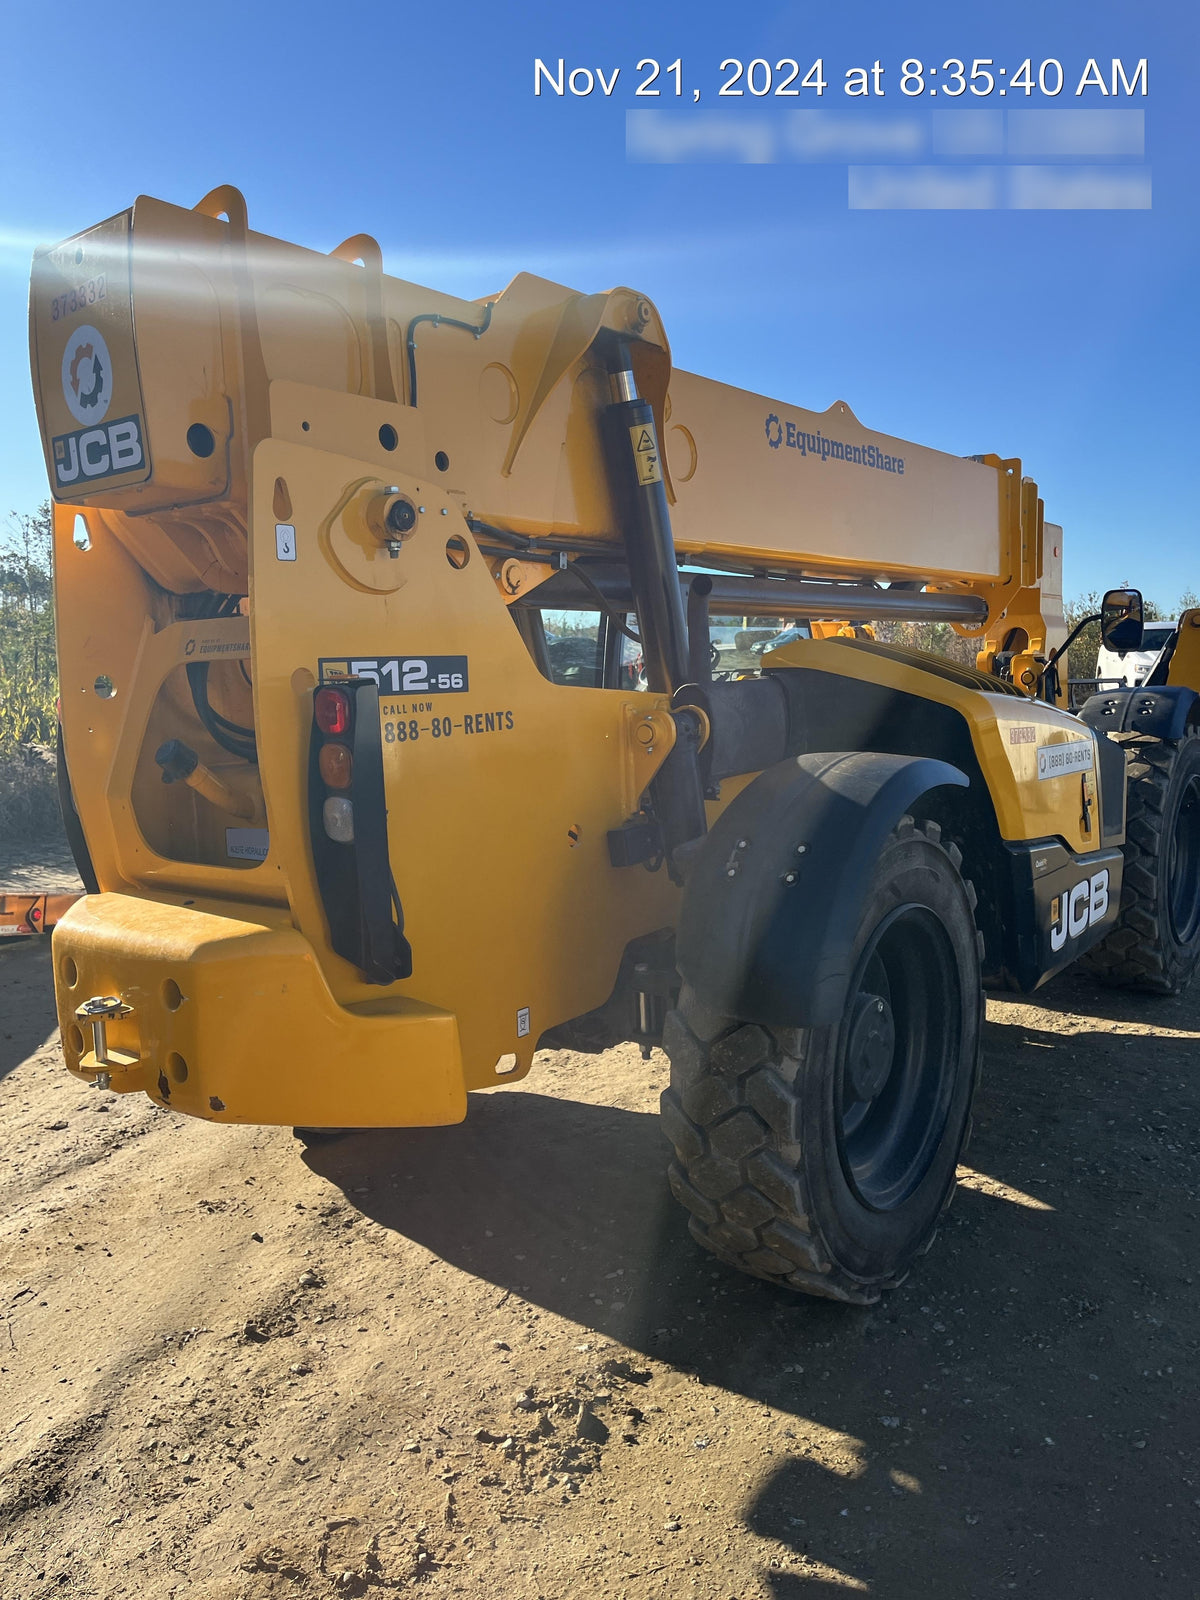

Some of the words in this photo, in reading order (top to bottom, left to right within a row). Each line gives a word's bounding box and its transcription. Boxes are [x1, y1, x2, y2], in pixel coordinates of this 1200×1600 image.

[52, 275, 105, 321] 373332
[57, 421, 142, 482] JCB
[785, 421, 905, 475] EquipmentShare
[199, 642, 251, 654] EQUIPMENTSHAR
[383, 704, 408, 716] CALL
[412, 702, 433, 713] NOW
[385, 710, 514, 743] 888-80-RENTS
[1050, 868, 1110, 953] JCB
